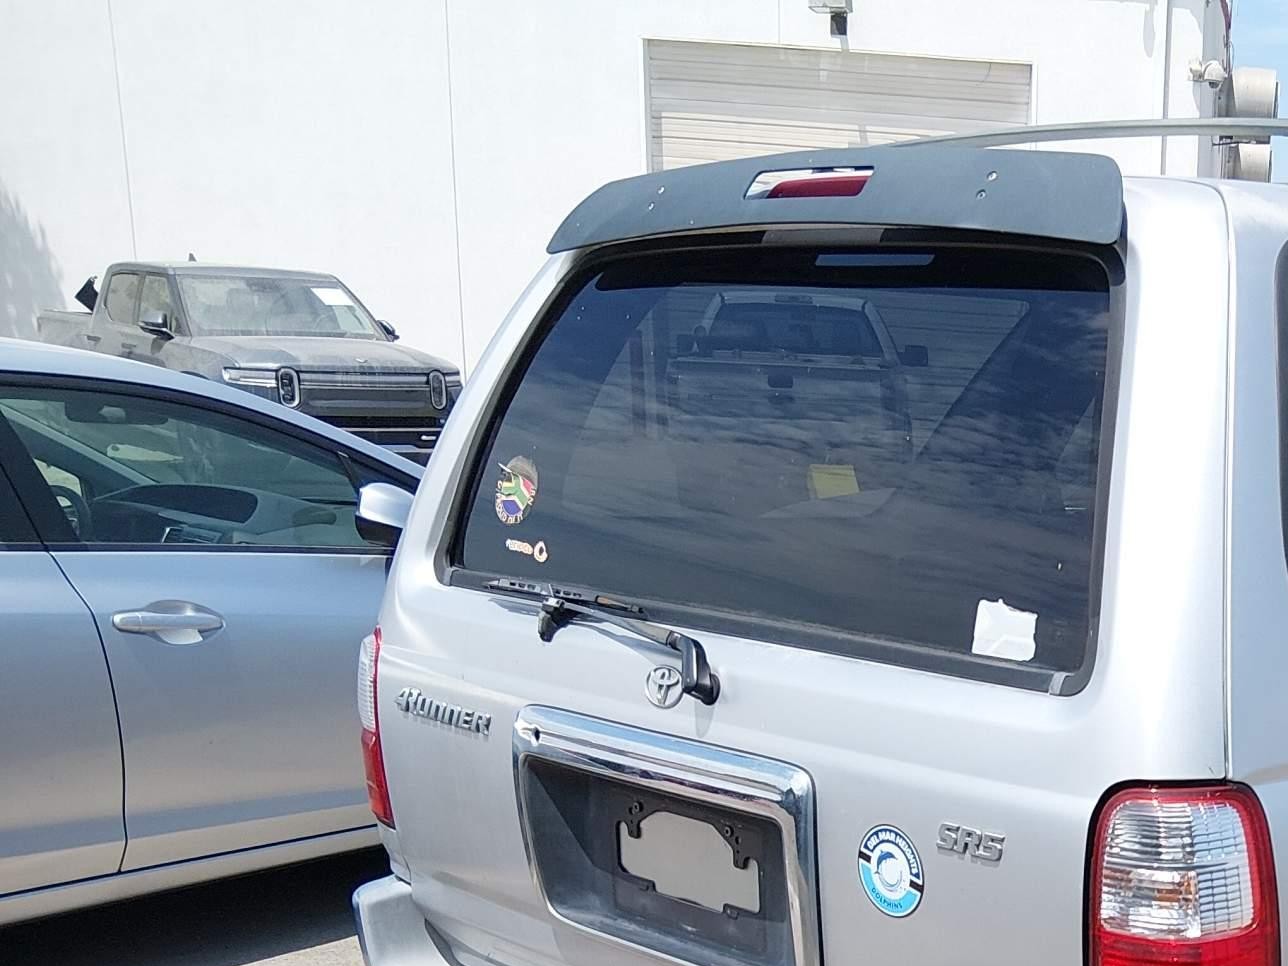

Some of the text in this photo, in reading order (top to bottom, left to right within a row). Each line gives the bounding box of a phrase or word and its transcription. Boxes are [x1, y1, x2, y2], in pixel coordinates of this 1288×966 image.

[866, 831, 919, 875] DEL MAR HEIGHTS
[936, 821, 1005, 861] SR5
[871, 887, 903, 909] DOLPHINS
